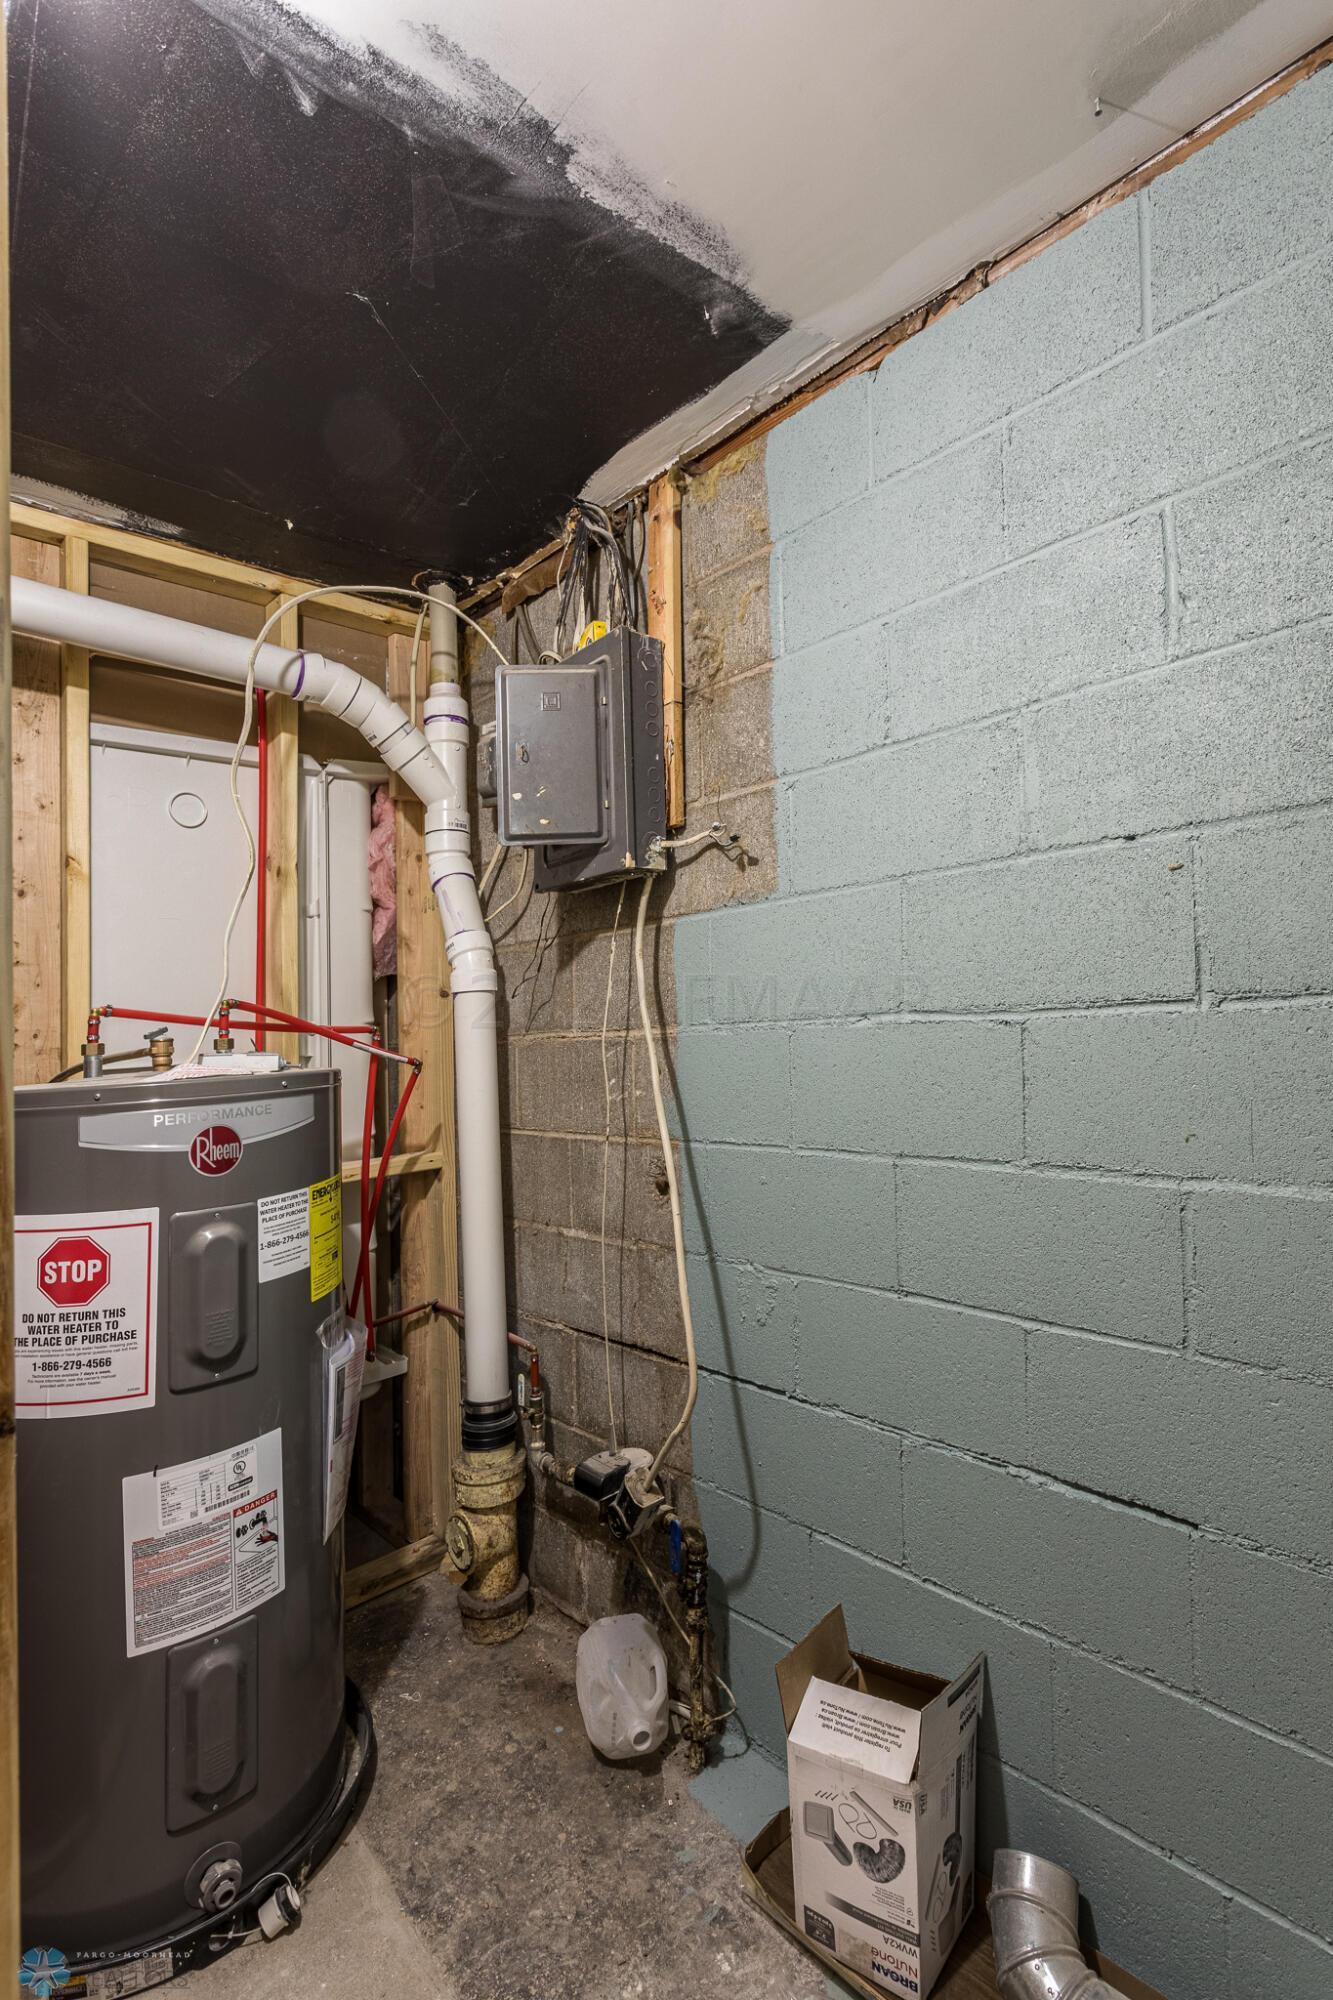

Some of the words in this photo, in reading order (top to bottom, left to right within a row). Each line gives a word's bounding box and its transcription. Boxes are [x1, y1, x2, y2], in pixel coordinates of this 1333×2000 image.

[153, 1103, 273, 1128] PERFORMANCE
[195, 1127, 240, 1169] Rheem
[260, 1207, 277, 1216] WATER
[277, 1202, 294, 1212] HEATER
[270, 1198, 280, 1206] NOT
[281, 1194, 298, 1203] RETURN
[261, 1215, 278, 1224] PLACE
[285, 1206, 308, 1217] PURCHASE
[44, 1259, 102, 1284] STOP
[22, 1313, 34, 1324] DO
[37, 1312, 56, 1323] NOT
[58, 1310, 99, 1322] RETURN
[102, 1307, 126, 1319] THIS
[27, 1325, 60, 1335] WATER
[62, 1322, 102, 1334] HEATER
[105, 1320, 119, 1331] TO
[32, 1336, 62, 1347] PLACE
[65, 1335, 78, 1346] OF
[81, 1329, 137, 1345] PURCHASE
[32, 1357, 112, 1372] 1-866-279-4566
[244, 1492, 276, 1512] DANGER
[892, 1798, 912, 1810] USA
[882, 1934, 918, 1959] WVK2A
[871, 1946, 918, 1979] NuTone
[871, 1960, 918, 1993] BROAN
